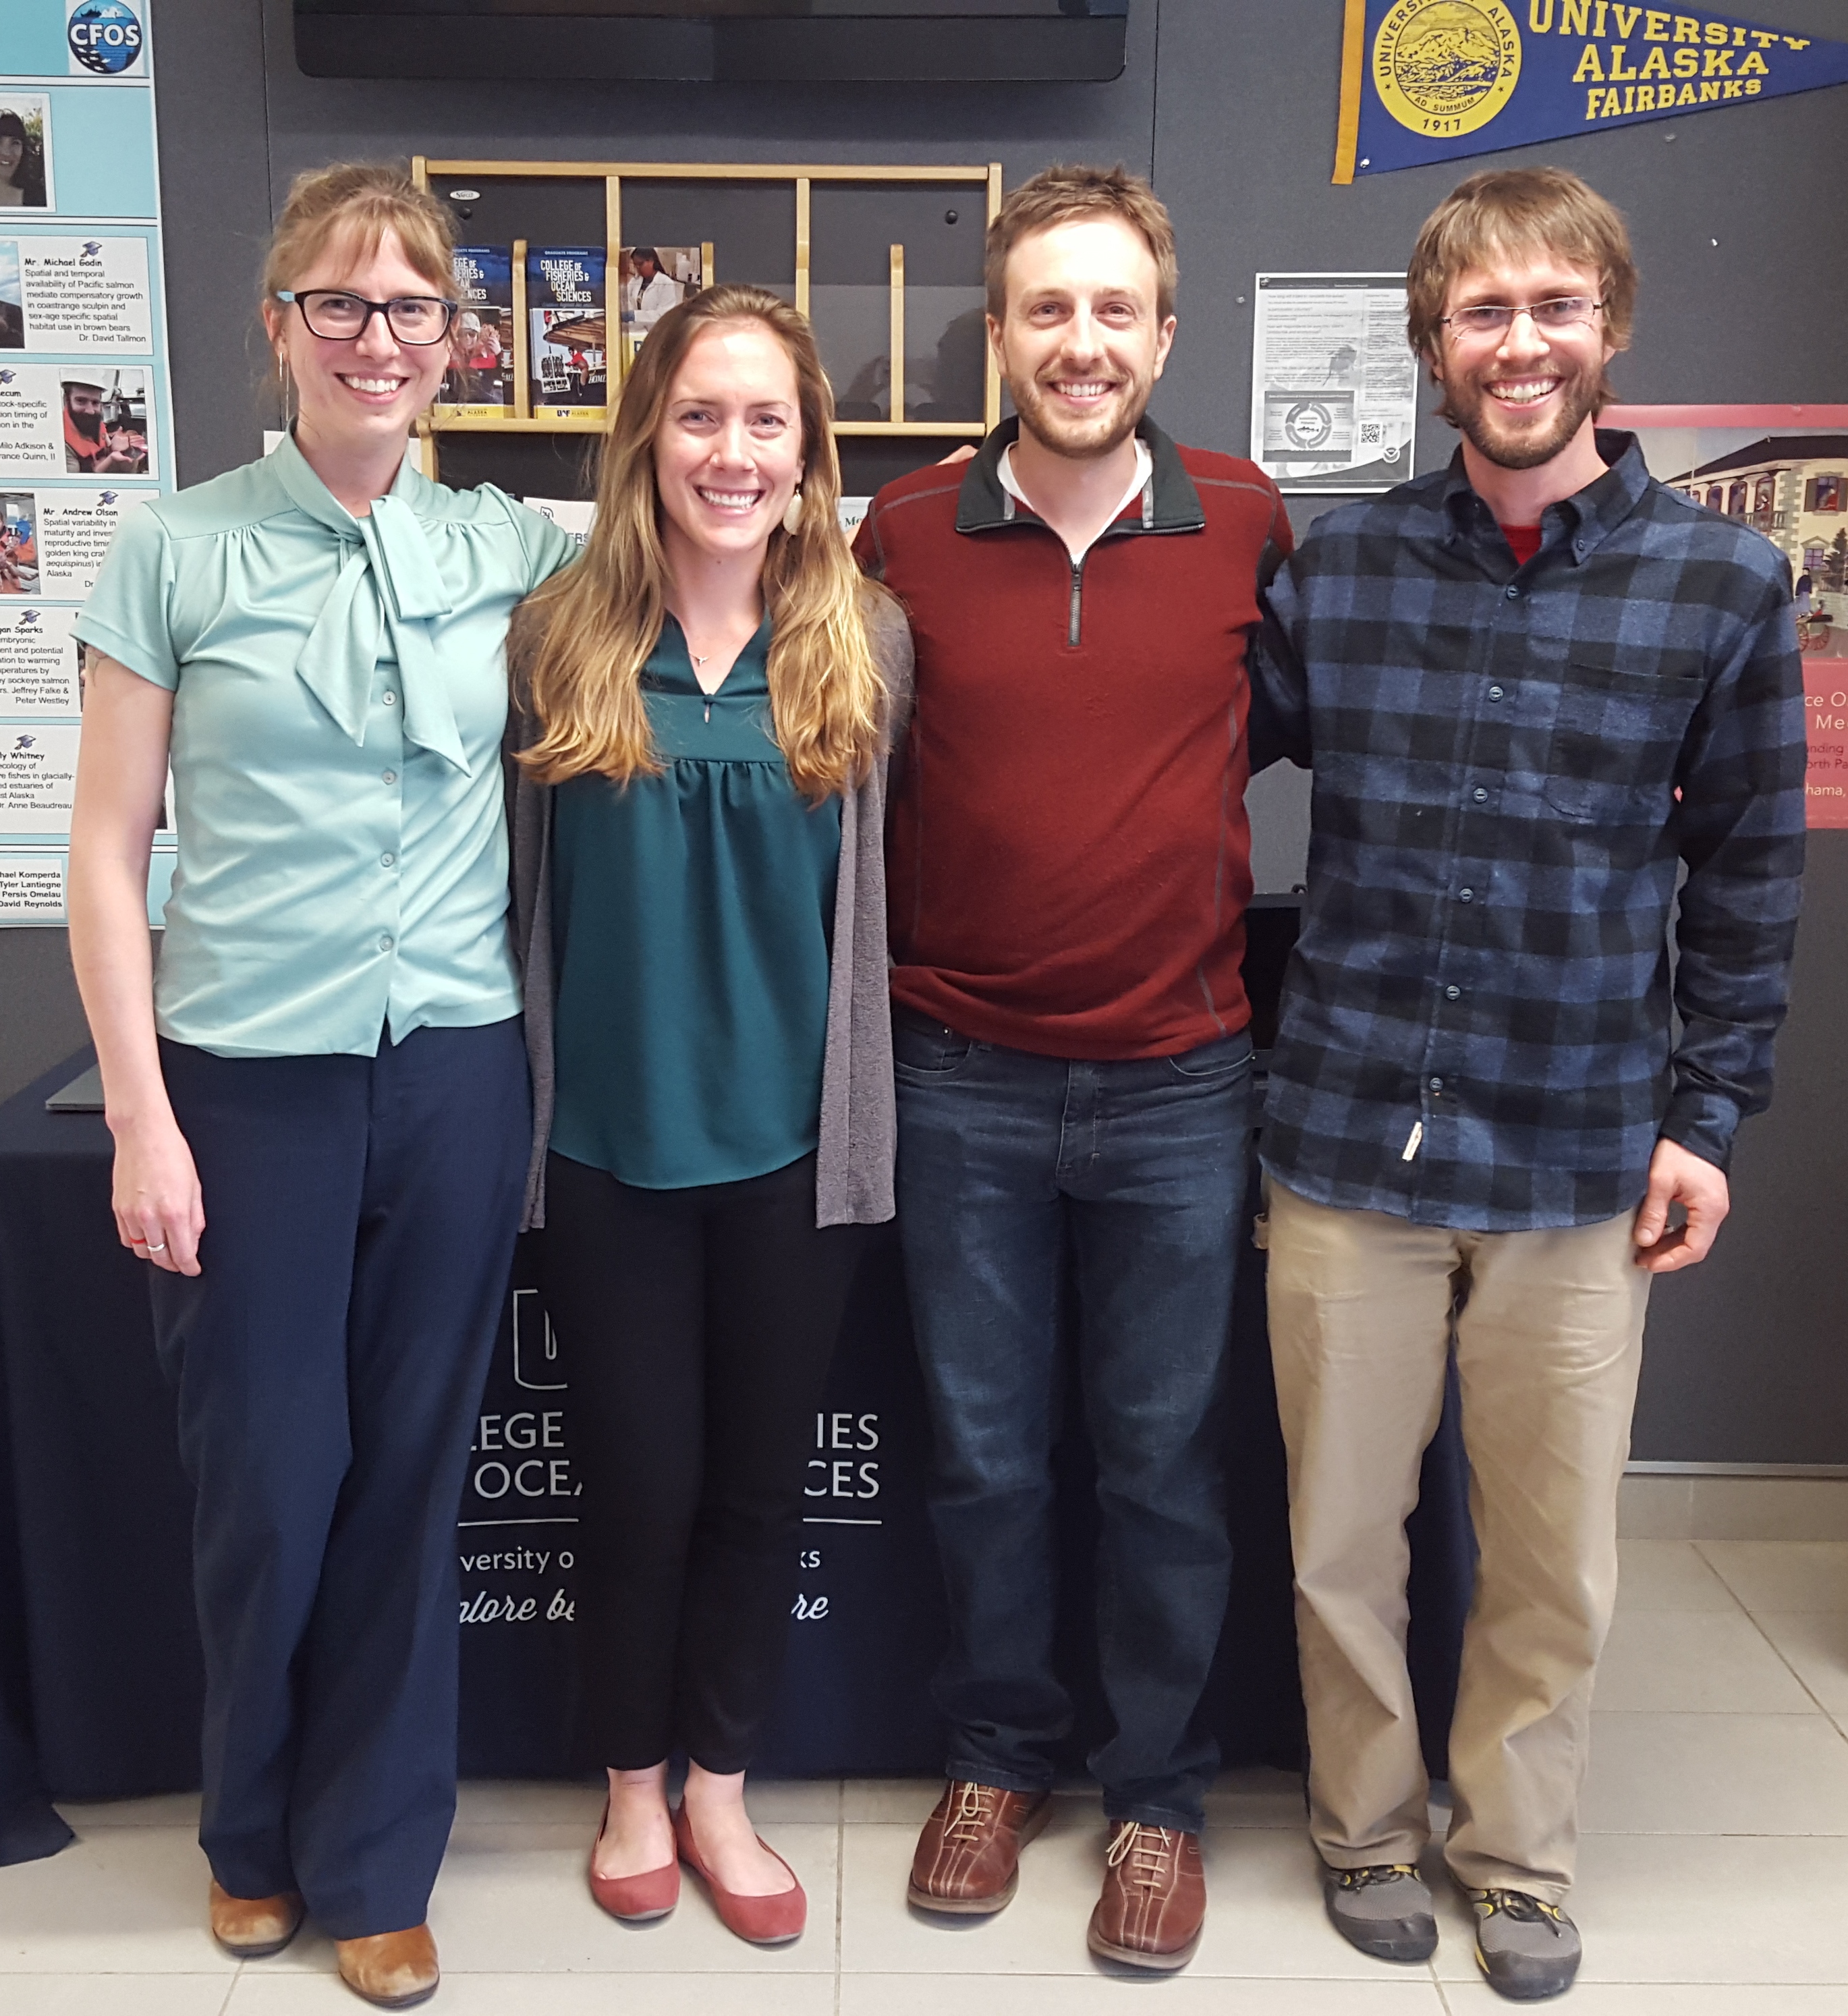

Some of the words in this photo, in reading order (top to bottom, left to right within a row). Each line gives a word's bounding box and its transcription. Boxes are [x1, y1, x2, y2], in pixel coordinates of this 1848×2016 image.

[1530, 0, 1810, 51] UNIVERSITY
[70, 24, 140, 46] CFOS
[1379, 0, 1431, 77] UNIVERS
[1488, 7, 1515, 78] ALASKA
[1572, 43, 1769, 83] ALASKA
[1586, 78, 1762, 120] FAIRBANKS
[1414, 96, 1428, 107] AD
[1432, 96, 1476, 113] SUMMUM
[1422, 117, 1461, 132] 1917
[44, 258, 76, 267] Michael
[79, 258, 103, 267] Godin
[540, 260, 573, 271] COLLEGE
[574, 262, 582, 271] OF
[25, 269, 52, 278] Spatial
[70, 270, 105, 279] temporal
[479, 270, 484, 279] &
[545, 270, 584, 281] FISHERIES
[584, 272, 590, 282] &
[26, 280, 66, 289] availability
[551, 281, 576, 291] OCEAN
[60, 291, 115, 301] compensatory
[117, 292, 144, 301] growth
[556, 291, 592, 302] SCIENCES
[36, 302, 80, 311] coastrange
[82, 302, 109, 311] sculpin
[28, 313, 60, 321] sex-age
[61, 313, 92, 321] specific
[93, 313, 119, 322] spatial
[92, 334, 115, 342] David
[117, 335, 147, 343] Tallmon
[14, 411, 38, 420] timing
[22, 421, 34, 429] the
[15, 442, 47, 450] Adkison
[48, 442, 55, 450] &
[22, 452, 49, 461] Quinn,
[62, 508, 92, 516] Andrew
[96, 508, 119, 517] Olson
[44, 518, 69, 527] Spatial
[72, 519, 108, 528] variability
[44, 530, 75, 538] maturity
[45, 539, 92, 548] reproductive
[45, 550, 71, 558] golden
[73, 550, 89, 559] king
[47, 569, 73, 578] Alaska
[15, 626, 43, 635] Sparks
[30, 647, 63, 655] potential
[27, 658, 60, 666] warming
[40, 667, 49, 676] by
[8, 677, 40, 685] sockeye
[11, 686, 38, 696] Jeffrey
[16, 696, 36, 704] Peter
[38, 697, 69, 706] Westley
[1805, 696, 1824, 707] ce
[1830, 692, 1848, 707] O
[1816, 714, 1848, 730] Me
[1808, 742, 1843, 756] nding
[10, 752, 45, 761] Whitney
[42, 772, 75, 781] glacially-
[1805, 782, 1847, 798] hama,
[19, 871, 61, 880] Komperda
[0, 880, 19, 890] Tyler
[21, 880, 61, 890] Lantiegne
[24, 900, 63, 909] Reynolds
[470, 1411, 565, 1451] EGE
[816, 1413, 879, 1451] IES
[474, 1459, 583, 1499] OCE
[460, 1546, 551, 1575] versity
[559, 1551, 573, 1569] o
[791, 1593, 829, 1620] re
